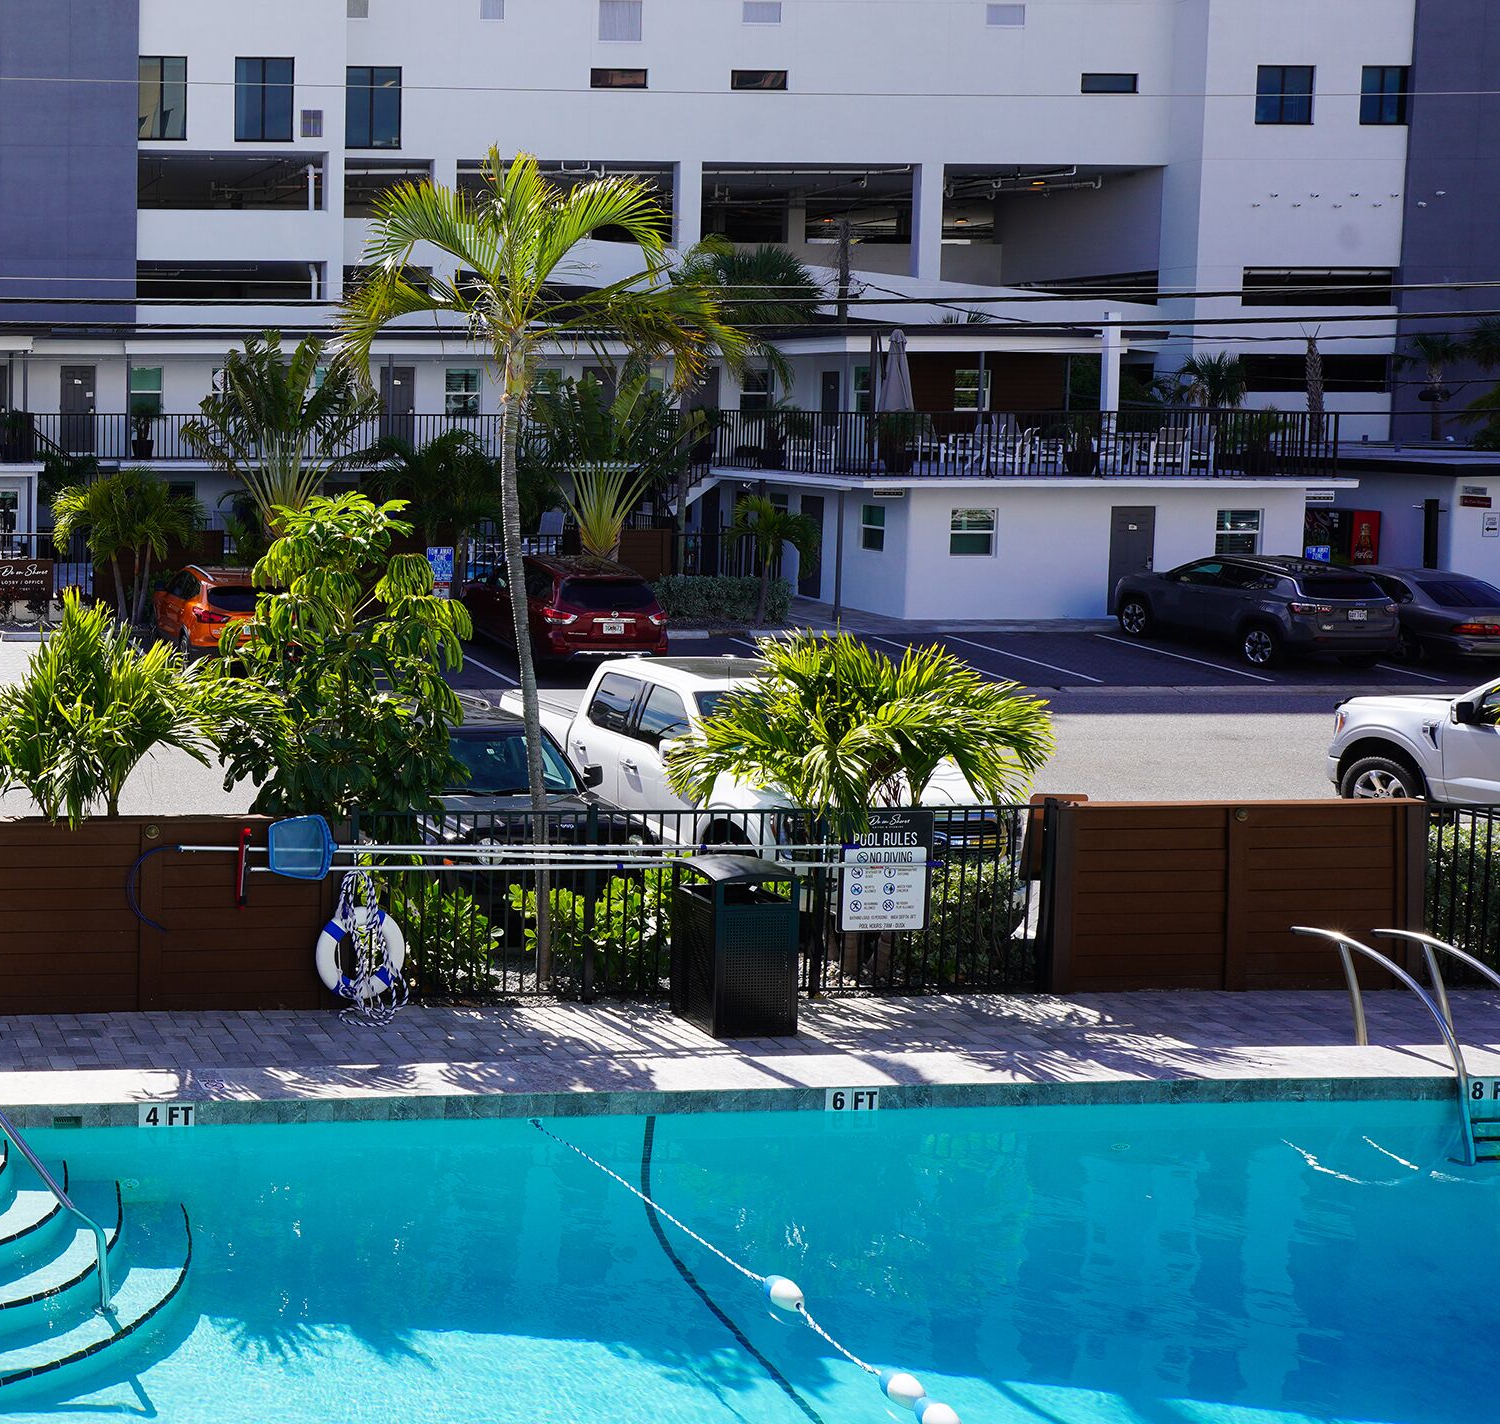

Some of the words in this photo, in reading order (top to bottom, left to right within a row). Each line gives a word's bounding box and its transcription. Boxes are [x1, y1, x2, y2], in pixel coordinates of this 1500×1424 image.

[853, 832, 881, 847] POOL
[883, 831, 918, 846] RULES
[869, 851, 882, 863] NO
[884, 851, 913, 863] DIVING
[833, 1092, 845, 1110] 6
[853, 1091, 878, 1110] FT
[1471, 1081, 1485, 1101] 8
[1493, 1081, 1500, 1100] F
[145, 1106, 159, 1126] 4
[168, 1106, 193, 1126] FT
